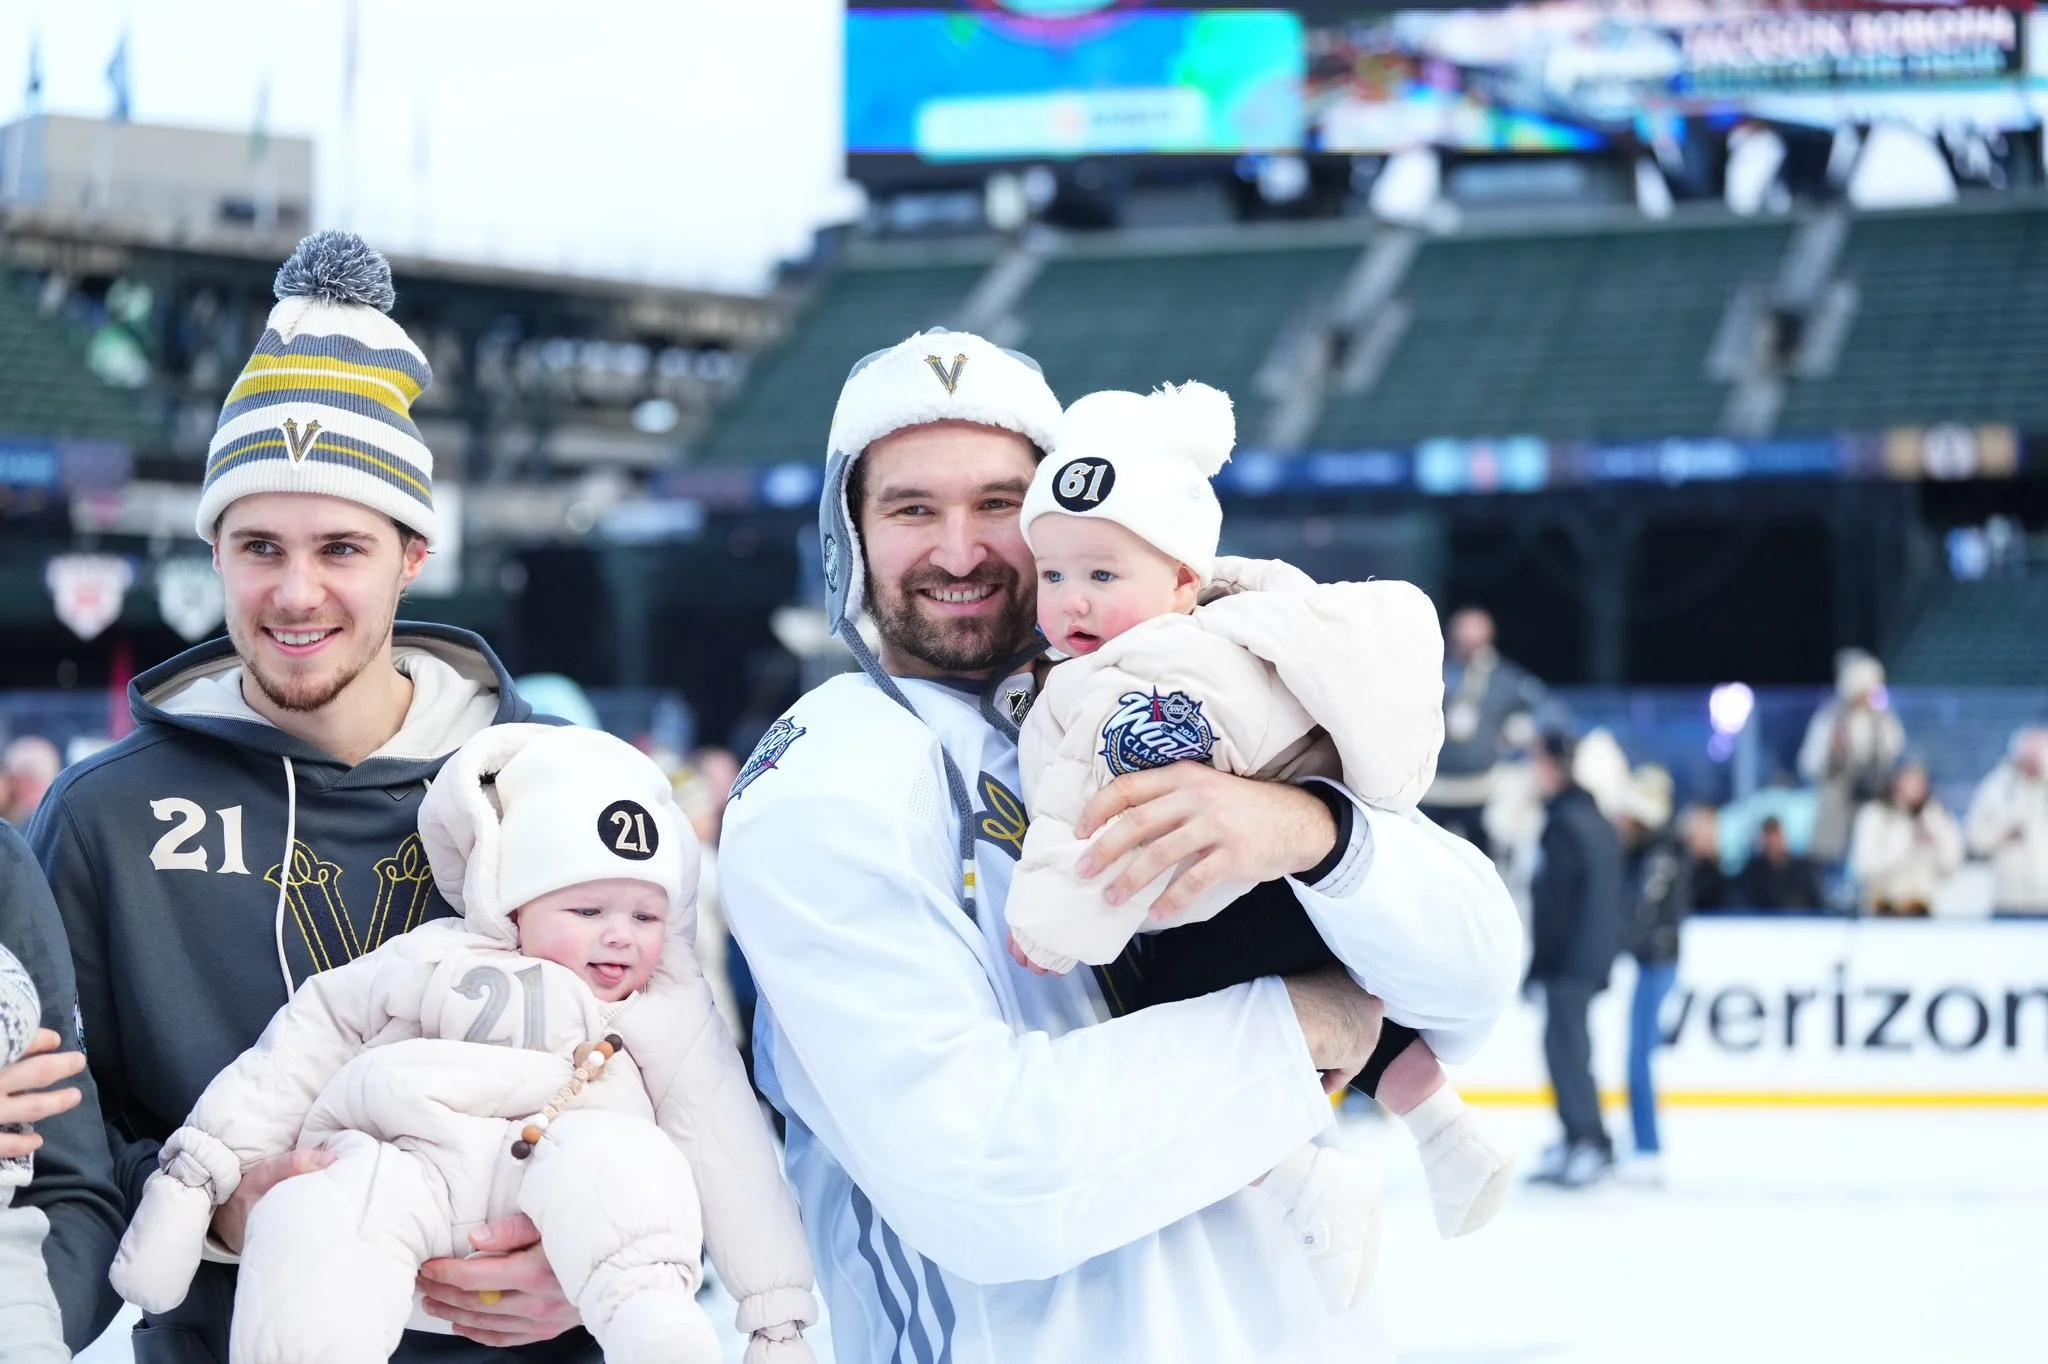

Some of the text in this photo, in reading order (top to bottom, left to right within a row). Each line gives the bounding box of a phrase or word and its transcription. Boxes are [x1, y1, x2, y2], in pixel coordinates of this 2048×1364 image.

[924, 353, 969, 397] V
[283, 417, 322, 467] V
[1059, 462, 1107, 502] 61
[1168, 705, 1187, 713] NHL
[1124, 735, 1172, 765] CLASSI
[1177, 725, 1198, 742] 2024
[1126, 752, 1154, 768] SEATT
[148, 797, 252, 875] 21
[610, 810, 650, 854] 21
[451, 963, 547, 1052] 21
